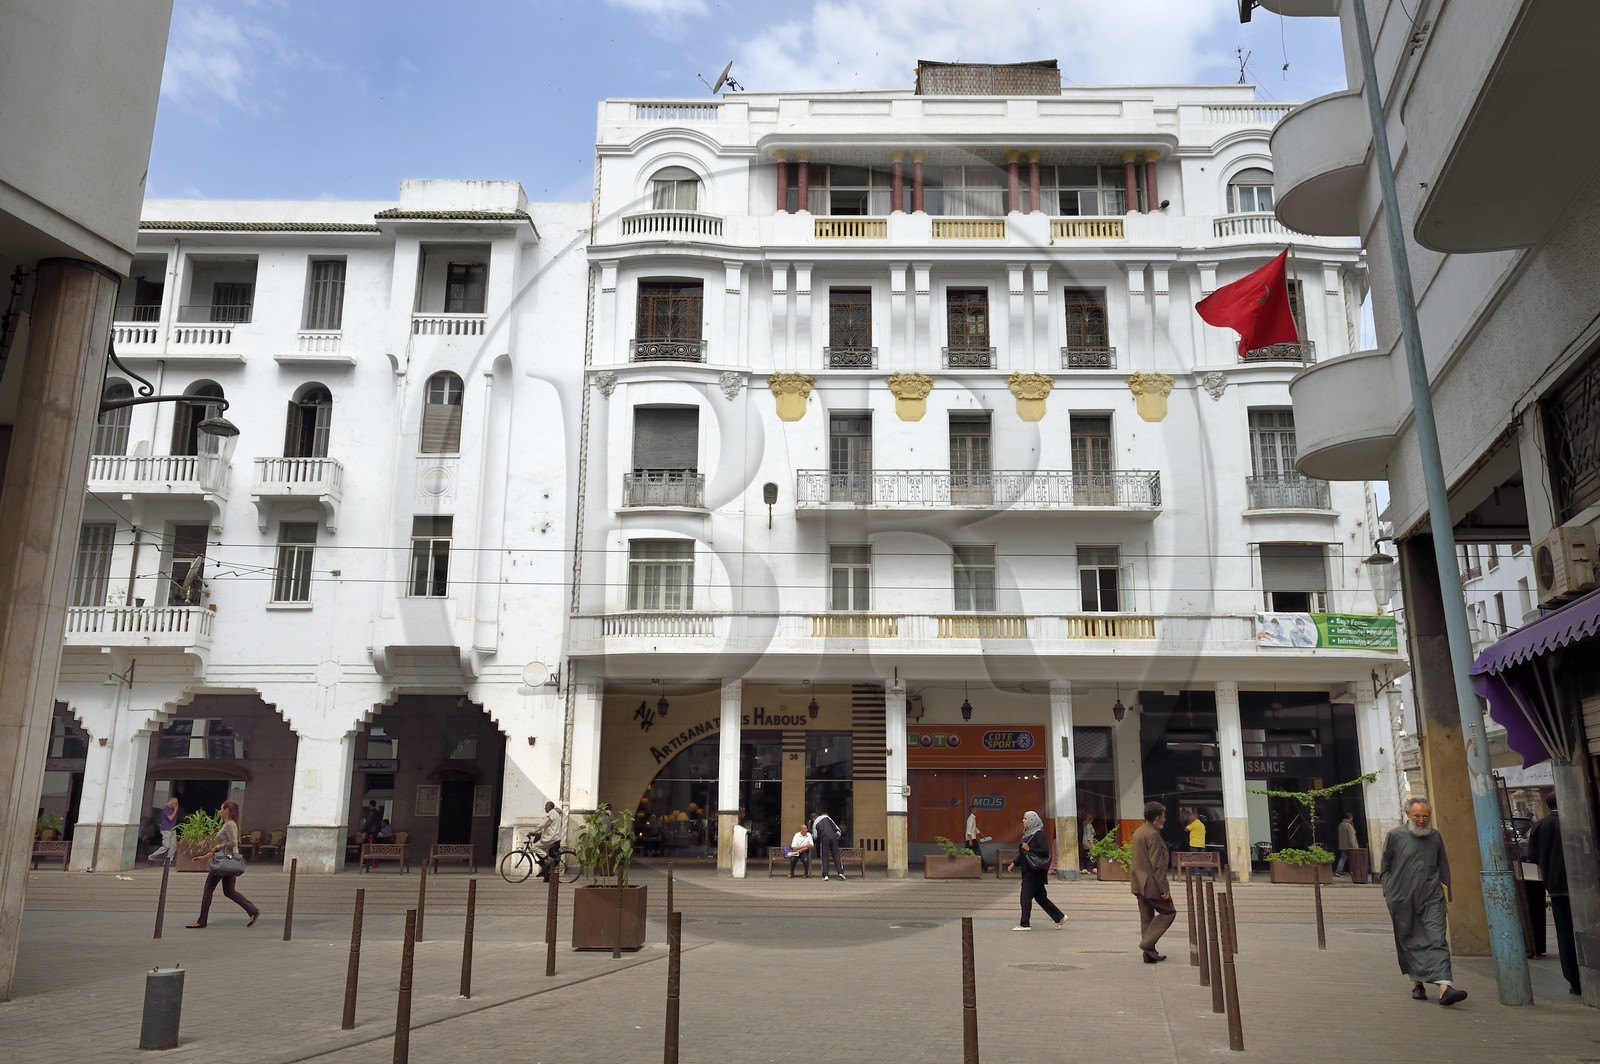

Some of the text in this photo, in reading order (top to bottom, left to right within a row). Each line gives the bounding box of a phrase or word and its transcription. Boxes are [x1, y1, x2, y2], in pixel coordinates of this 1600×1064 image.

[753, 707, 807, 725] HABOUS
[907, 732, 961, 749] LOTO
[987, 740, 1017, 749] SPORT
[789, 753, 799, 761] 36
[1201, 760, 1286, 773] LA ISSANCE
[973, 797, 1003, 807] MDJS
